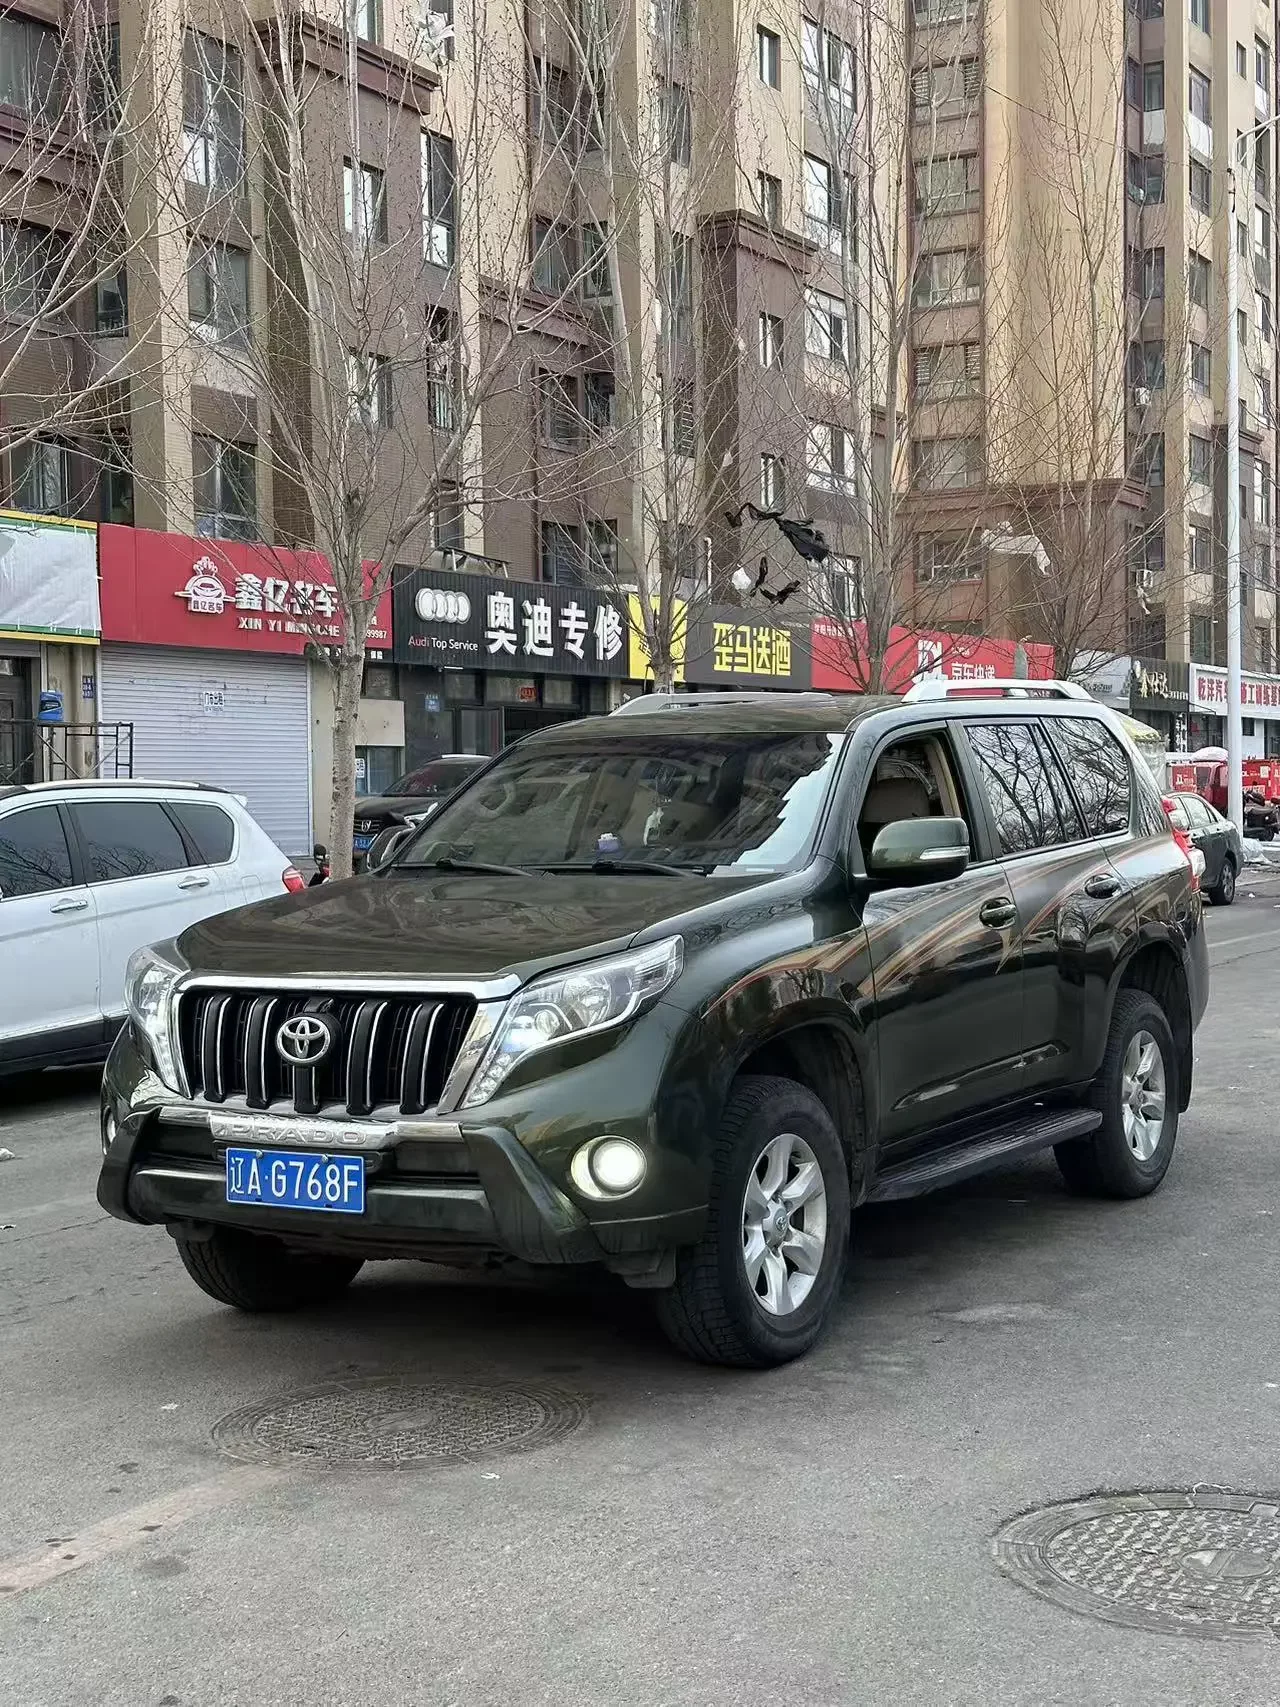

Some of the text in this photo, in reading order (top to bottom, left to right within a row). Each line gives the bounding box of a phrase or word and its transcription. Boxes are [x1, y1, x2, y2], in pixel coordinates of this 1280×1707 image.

[235, 573, 338, 618] 鑫亿名车
[238, 616, 263, 631] XIN
[267, 618, 282, 632] YI
[484, 591, 623, 661] 奥迪专修
[408, 635, 479, 651] Audi Top Service
[713, 622, 792, 677] 歪马送酒
[951, 661, 996, 681] 京东快递
[231, 1124, 366, 1145] PRADO
